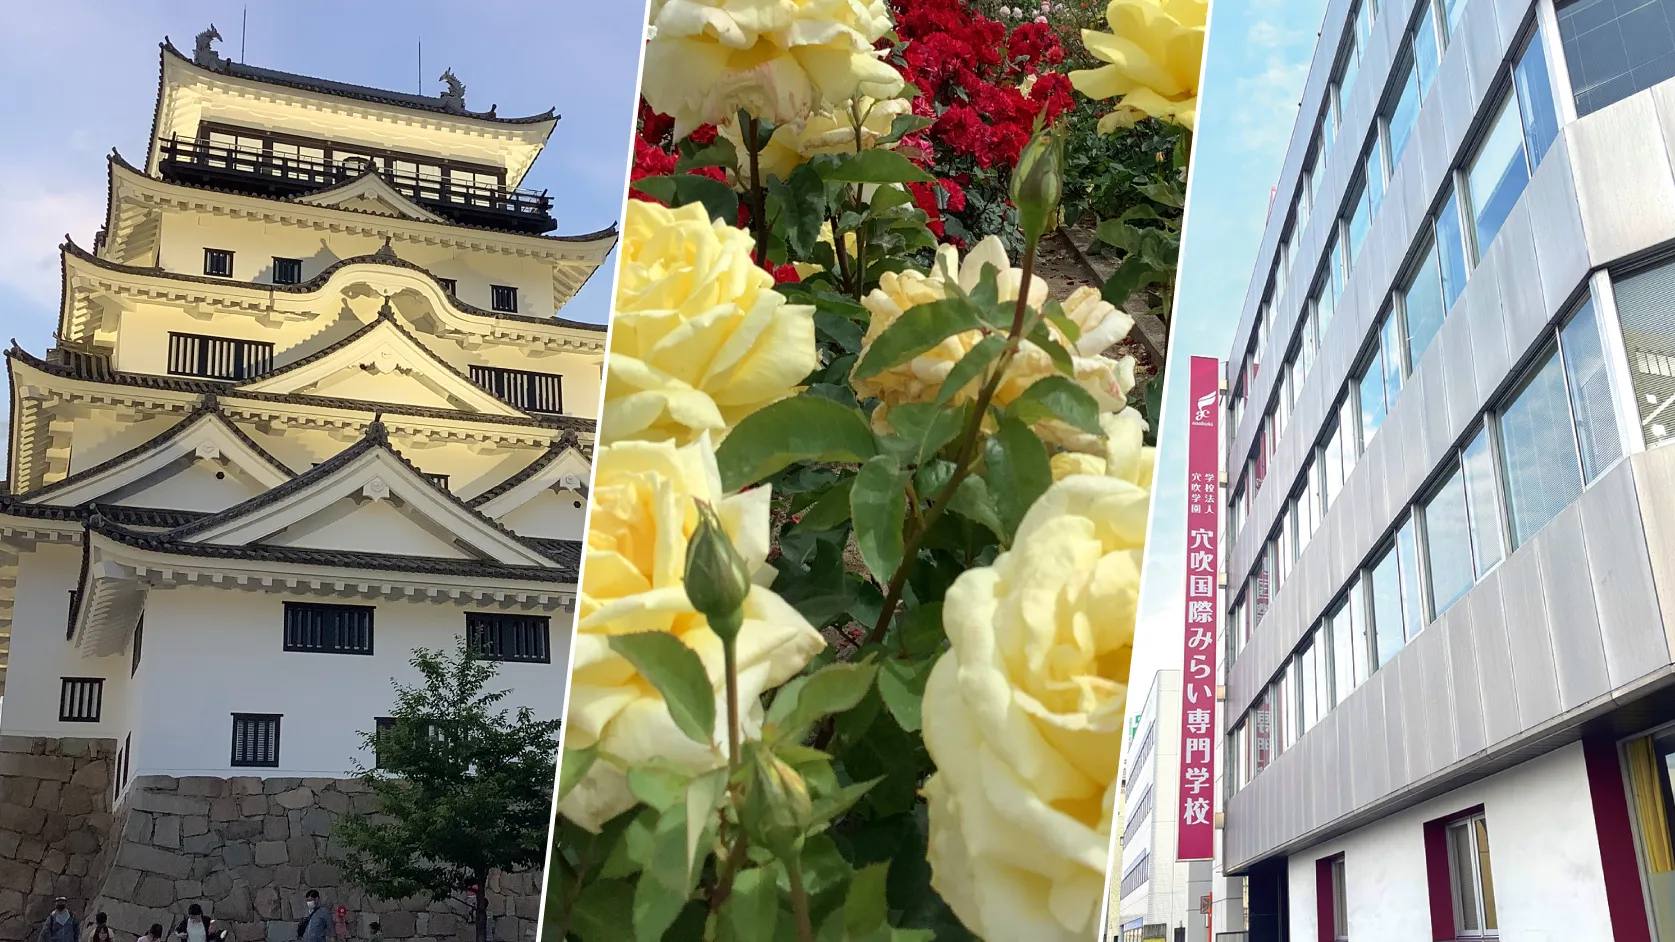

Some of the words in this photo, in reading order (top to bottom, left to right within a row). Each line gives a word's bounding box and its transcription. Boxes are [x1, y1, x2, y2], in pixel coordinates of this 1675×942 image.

[1191, 472, 1202, 514] 穴吹学園
[1204, 472, 1215, 515] 学校法人
[1183, 528, 1214, 825] 穴吹国際みらい専門学校
